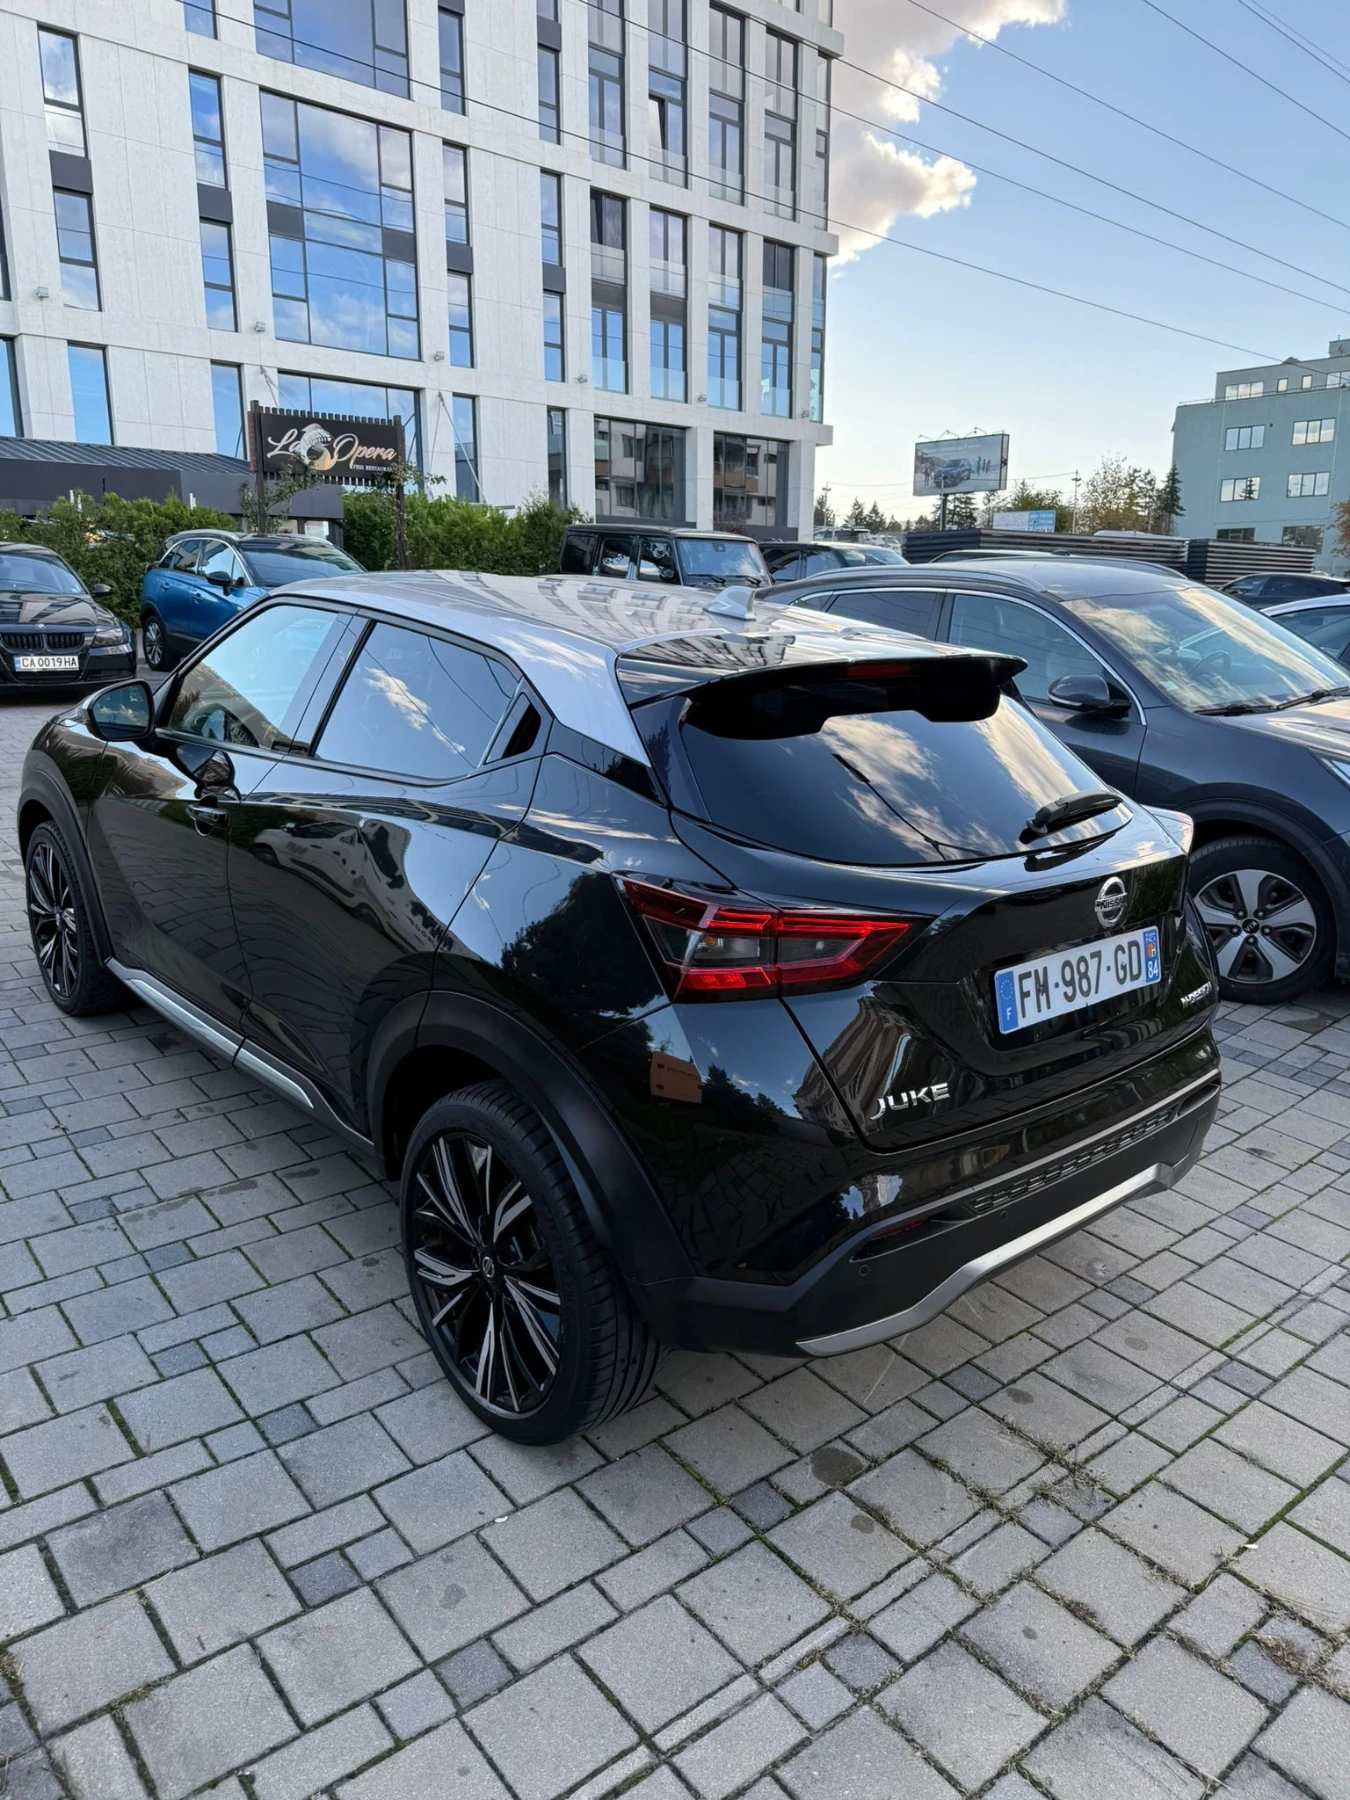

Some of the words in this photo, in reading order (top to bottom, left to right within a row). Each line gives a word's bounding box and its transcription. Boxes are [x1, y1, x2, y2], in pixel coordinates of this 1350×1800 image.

[332, 433, 397, 469] Opera
[22, 658, 36, 668] CA
[38, 657, 62, 667] 0019
[64, 657, 77, 667] HA
[1148, 959, 1158, 978] 84
[1006, 1007, 1013, 1021] F
[869, 1082, 950, 1120] JUKE
